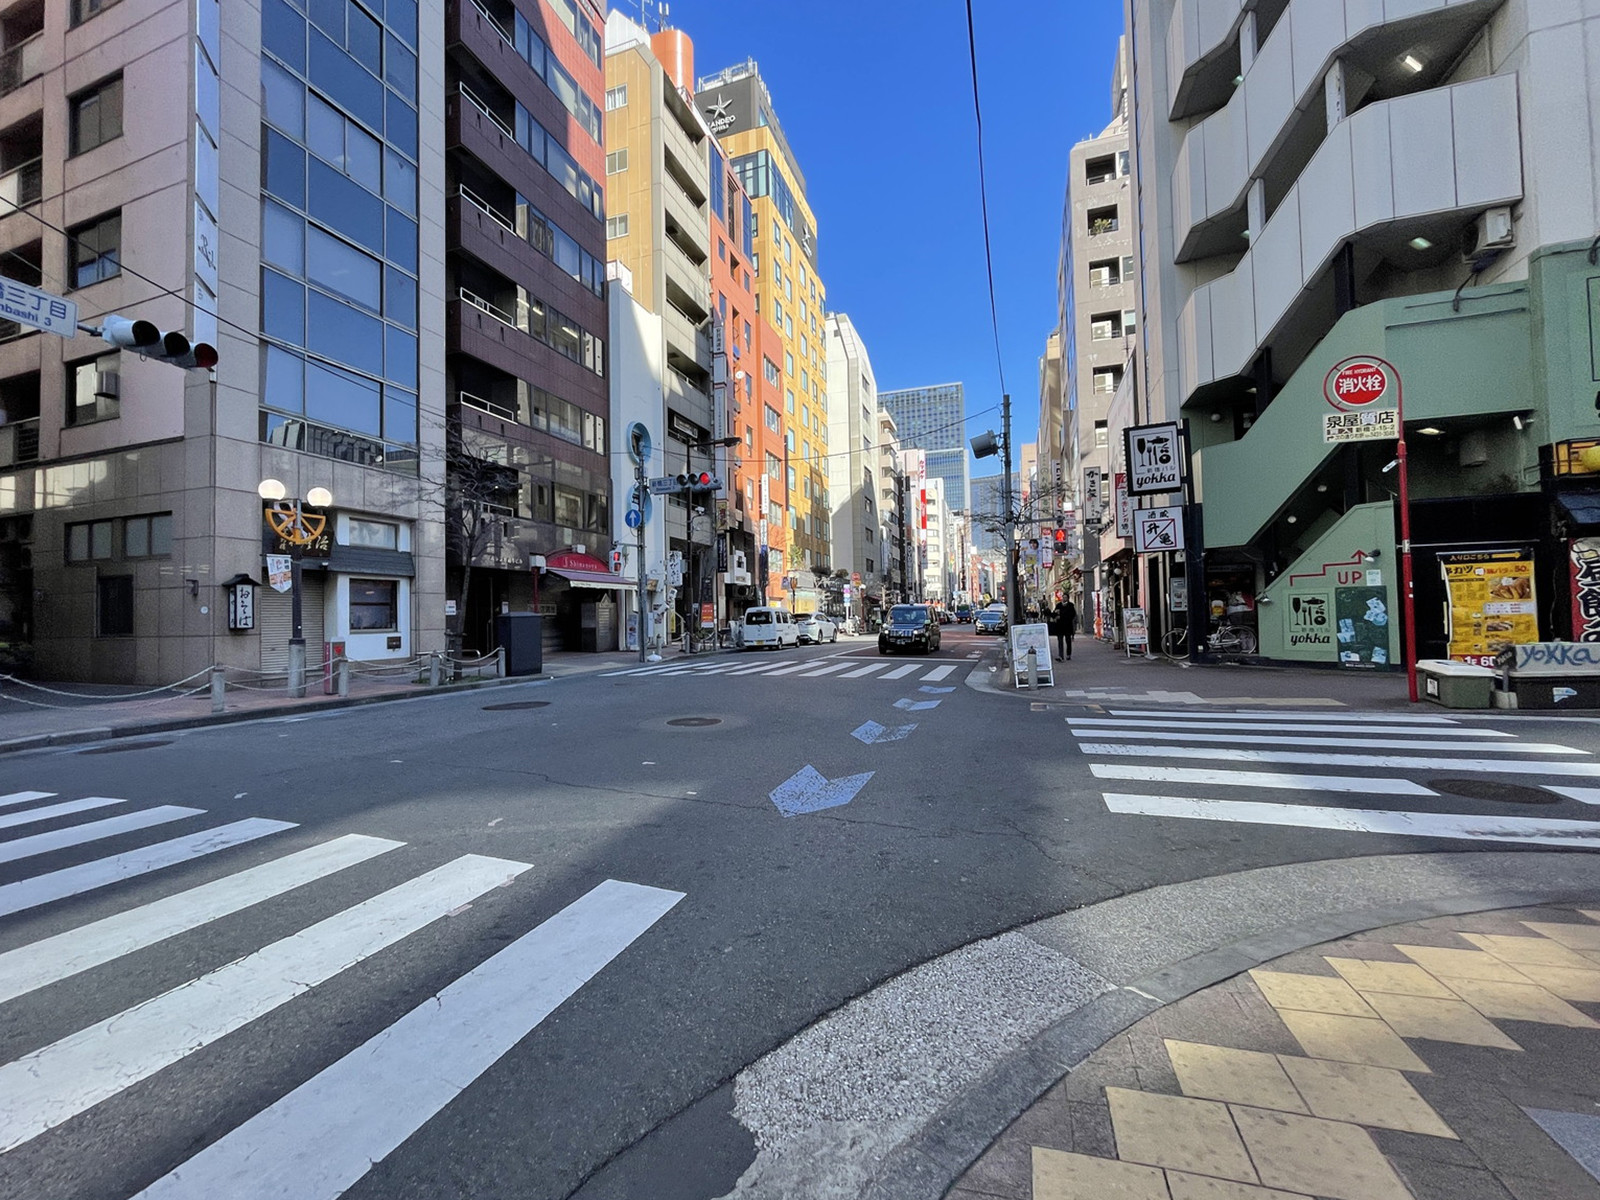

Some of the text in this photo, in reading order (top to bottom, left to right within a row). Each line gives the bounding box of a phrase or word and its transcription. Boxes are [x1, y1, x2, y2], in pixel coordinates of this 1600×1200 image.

[0, 282, 66, 320] 三丁目
[44, 317, 52, 326] 3
[1338, 374, 1382, 394] 消火栓
[1136, 471, 1176, 488] yokka
[1338, 571, 1362, 584] UP
[1290, 633, 1330, 646] yokka
